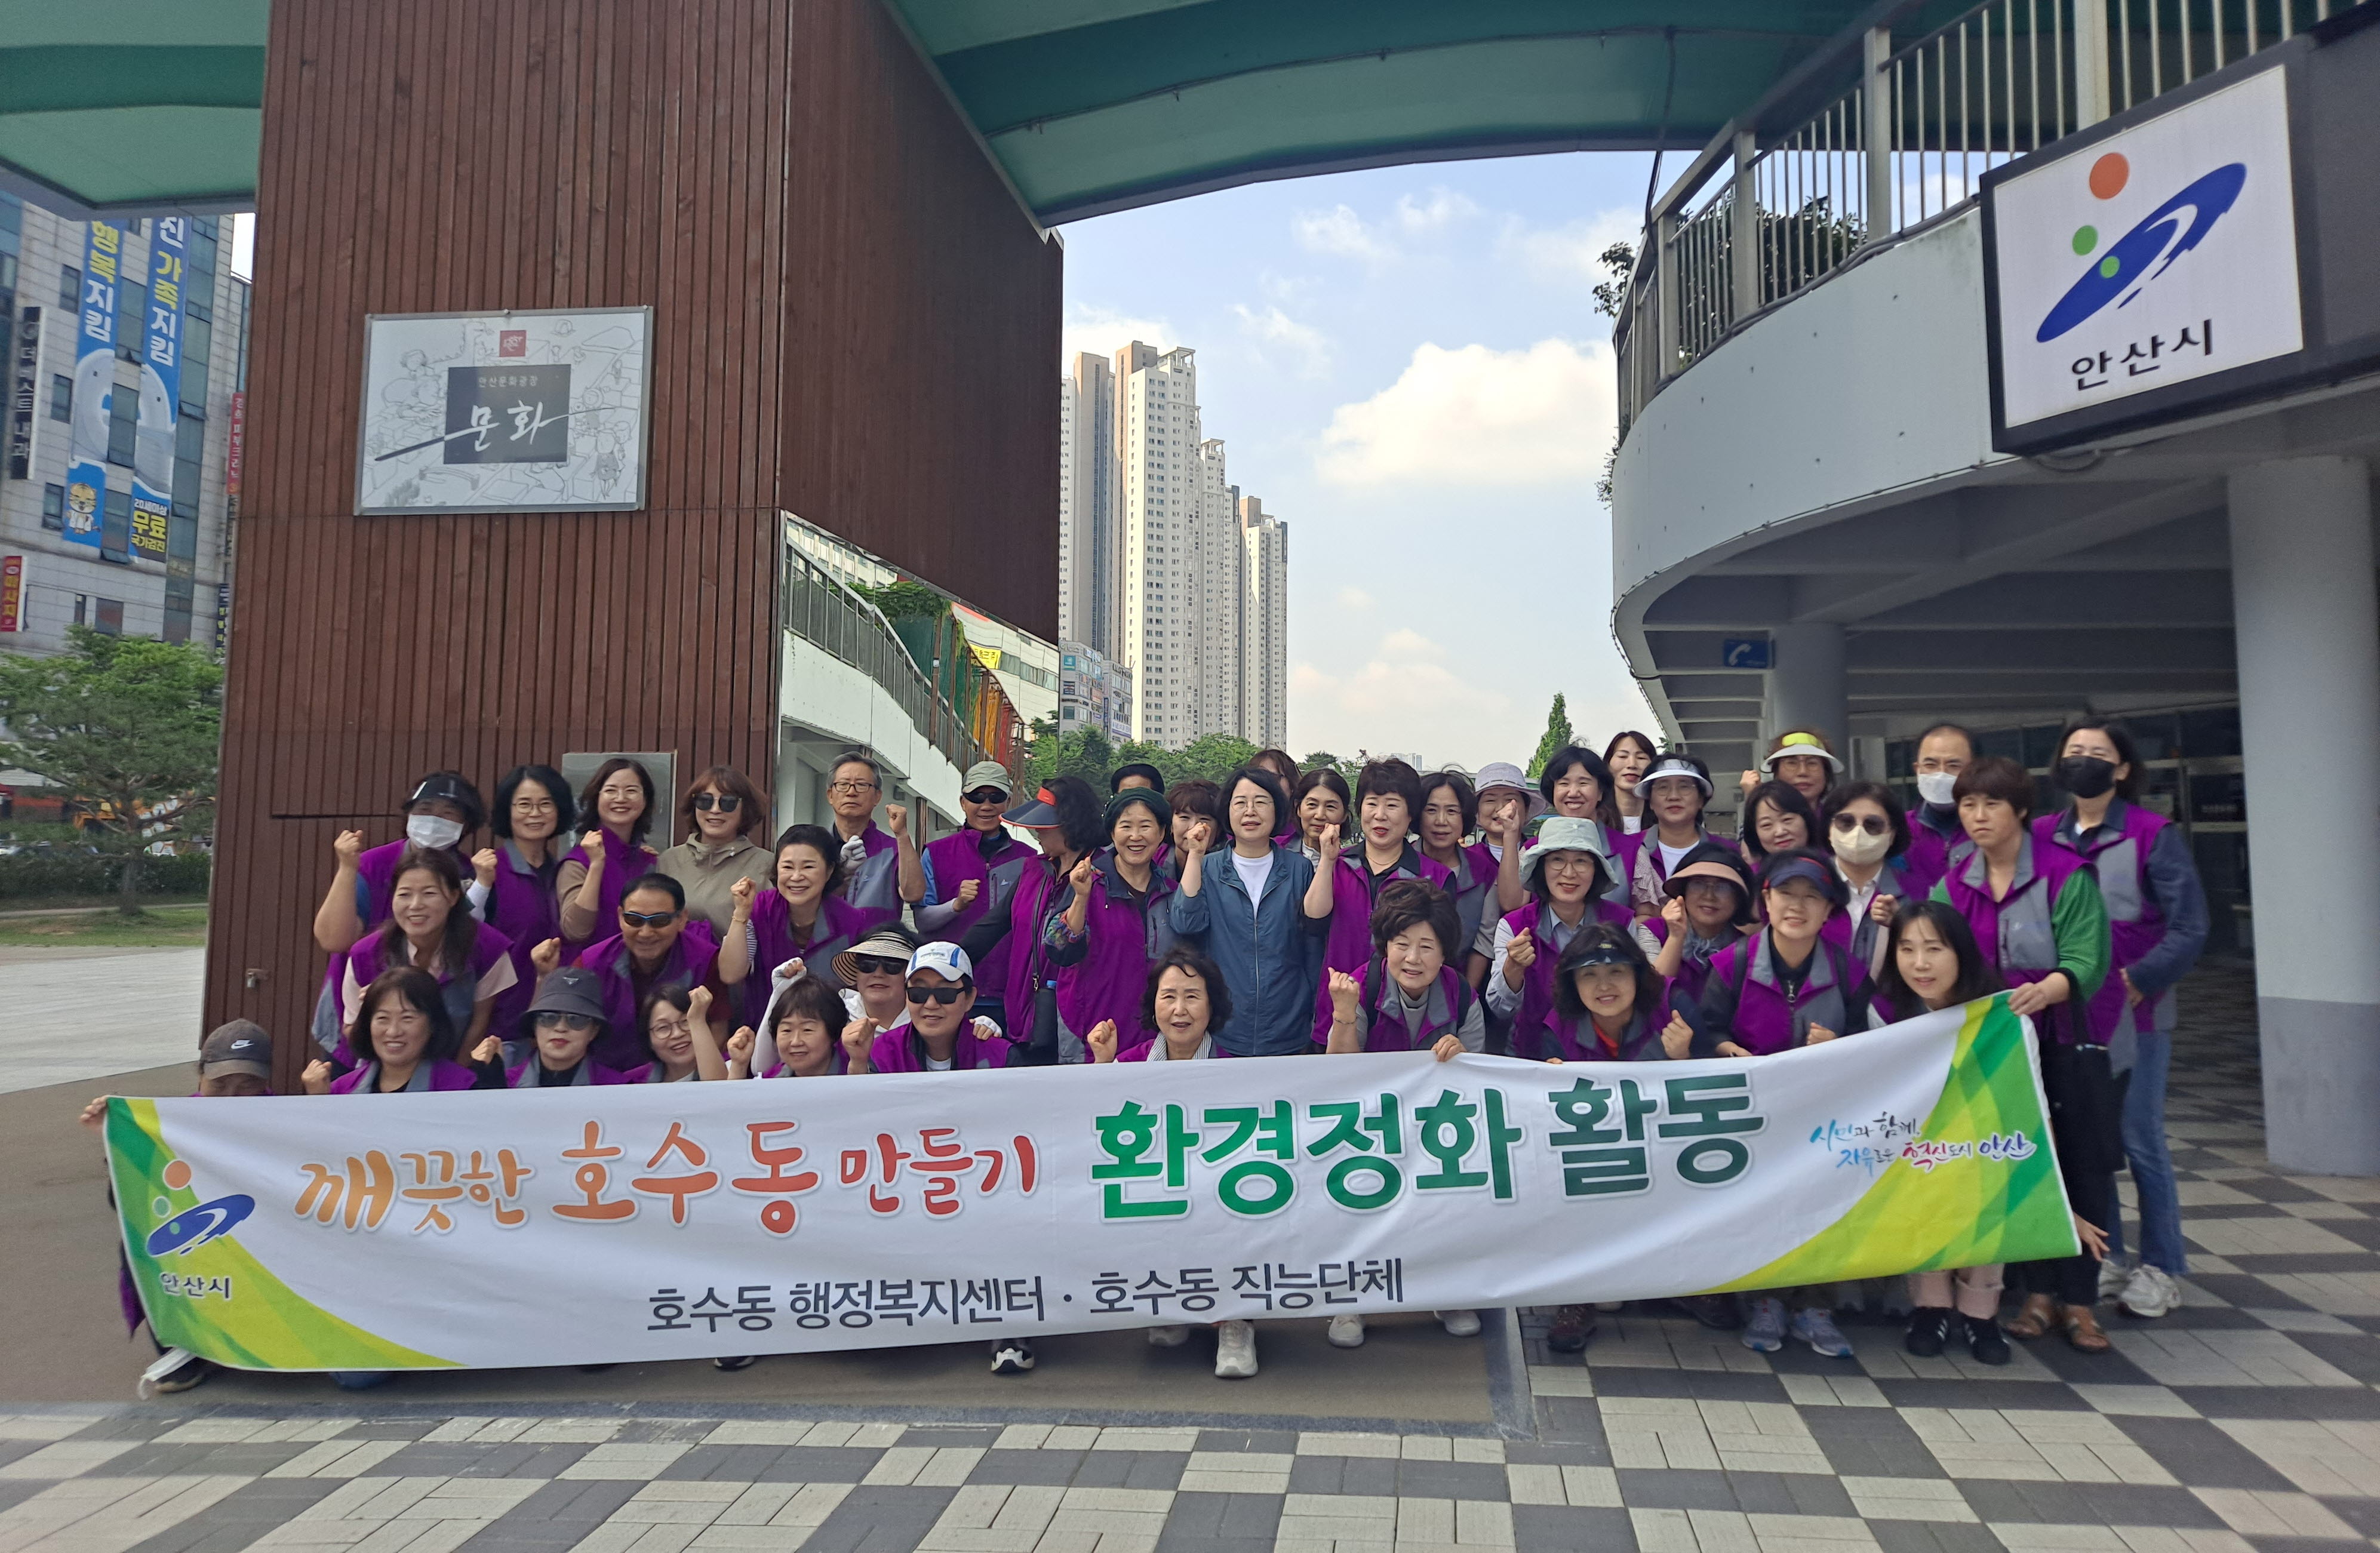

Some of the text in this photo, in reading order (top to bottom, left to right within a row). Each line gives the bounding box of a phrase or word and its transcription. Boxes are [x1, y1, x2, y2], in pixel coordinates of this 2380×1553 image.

[2071, 319, 2213, 391] 안산시
[478, 376, 538, 388] 안산문화광장
[132, 510, 166, 539] 무료
[294, 1073, 1763, 1234] 깨끗한 호수동 만들기 환경정화 활동
[1810, 1119, 1873, 1152] 시민과
[1902, 1141, 1972, 1171] 혁신도시
[1978, 1132, 2036, 1161] 안산
[161, 1273, 231, 1300] 안산시
[647, 1283, 776, 1332] 호수동
[789, 1275, 1045, 1331] 행정복지센터
[1090, 1267, 1220, 1315] 호수동
[1231, 1257, 1404, 1311] 직능단체
